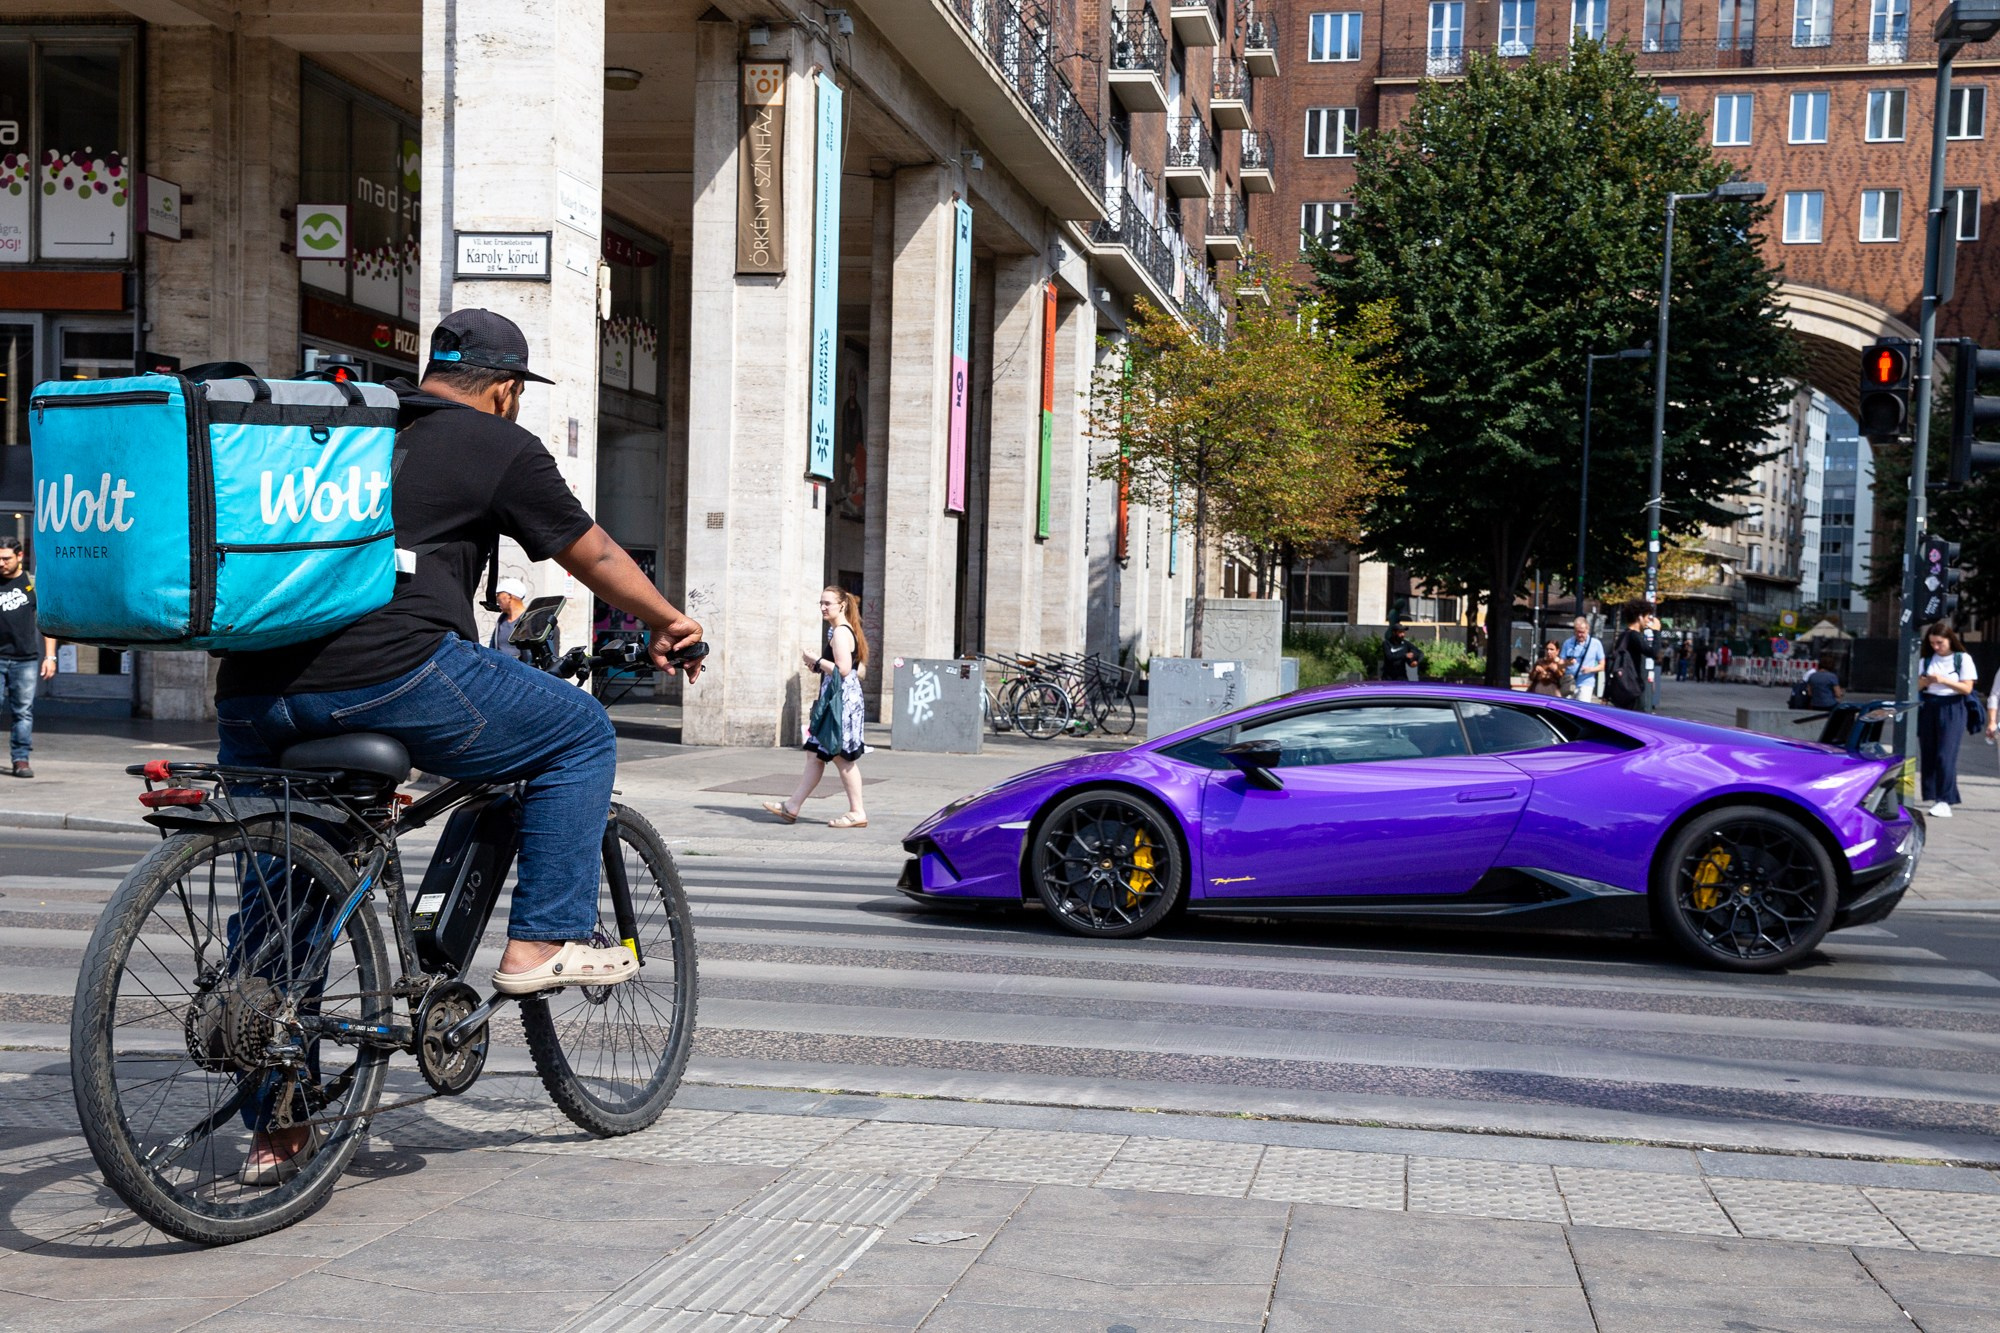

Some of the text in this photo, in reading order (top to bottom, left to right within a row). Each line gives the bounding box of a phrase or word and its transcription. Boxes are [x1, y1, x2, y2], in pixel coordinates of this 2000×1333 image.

[749, 109, 773, 267] ÖRKÉNY SZÍNHÁZ
[466, 248, 503, 266] Károly
[822, 328, 830, 407] SZÍNHÁZ
[37, 472, 136, 533] Wolt
[260, 465, 389, 525] Wolt
[55, 545, 108, 559] PARTNER
